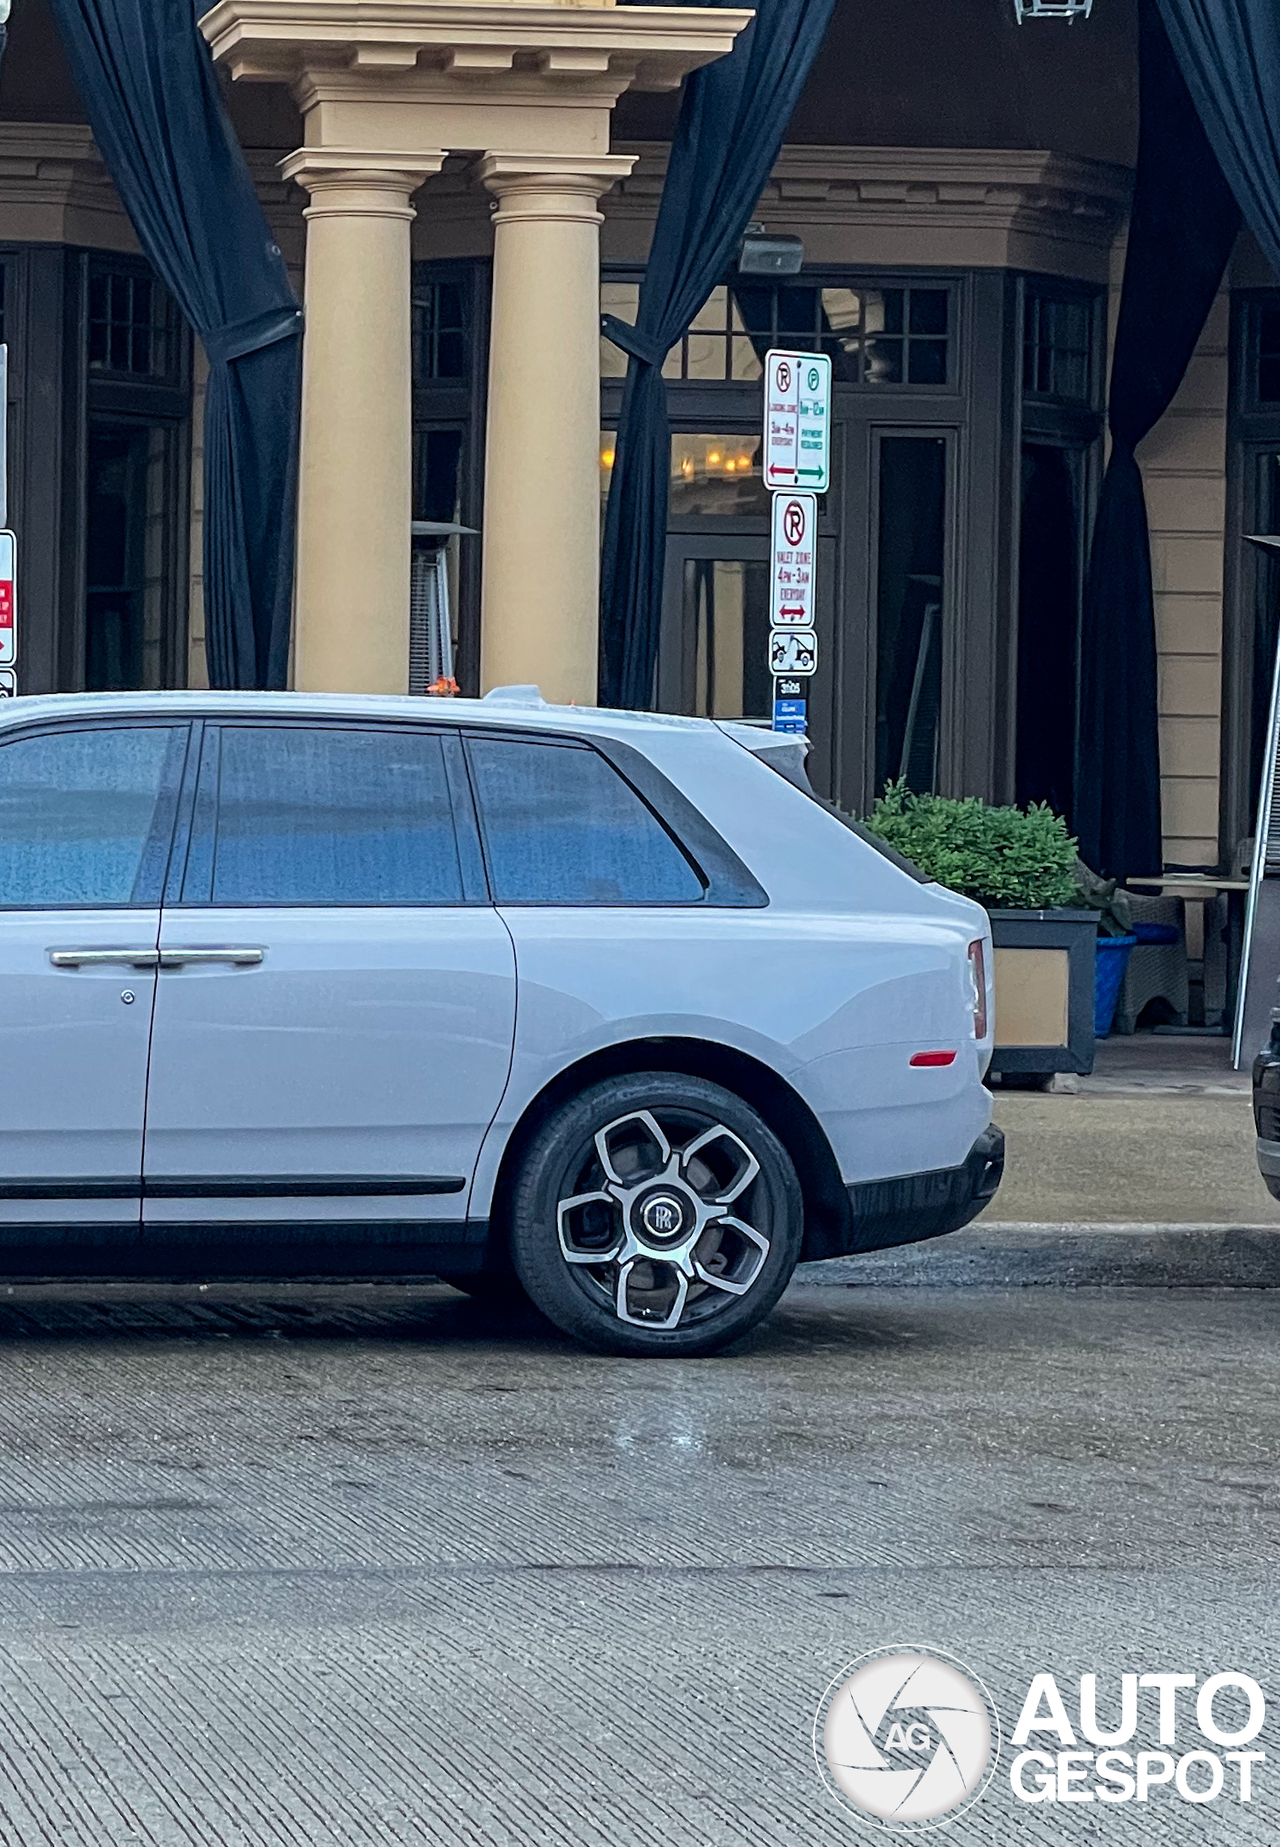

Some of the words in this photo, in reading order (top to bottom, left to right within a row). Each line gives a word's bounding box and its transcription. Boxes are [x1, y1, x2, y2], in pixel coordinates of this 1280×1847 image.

[777, 551, 793, 564] VALET
[796, 551, 811, 564] ZONE
[781, 588, 805, 601] EVERYDAY
[1, 601, 10, 610] UP
